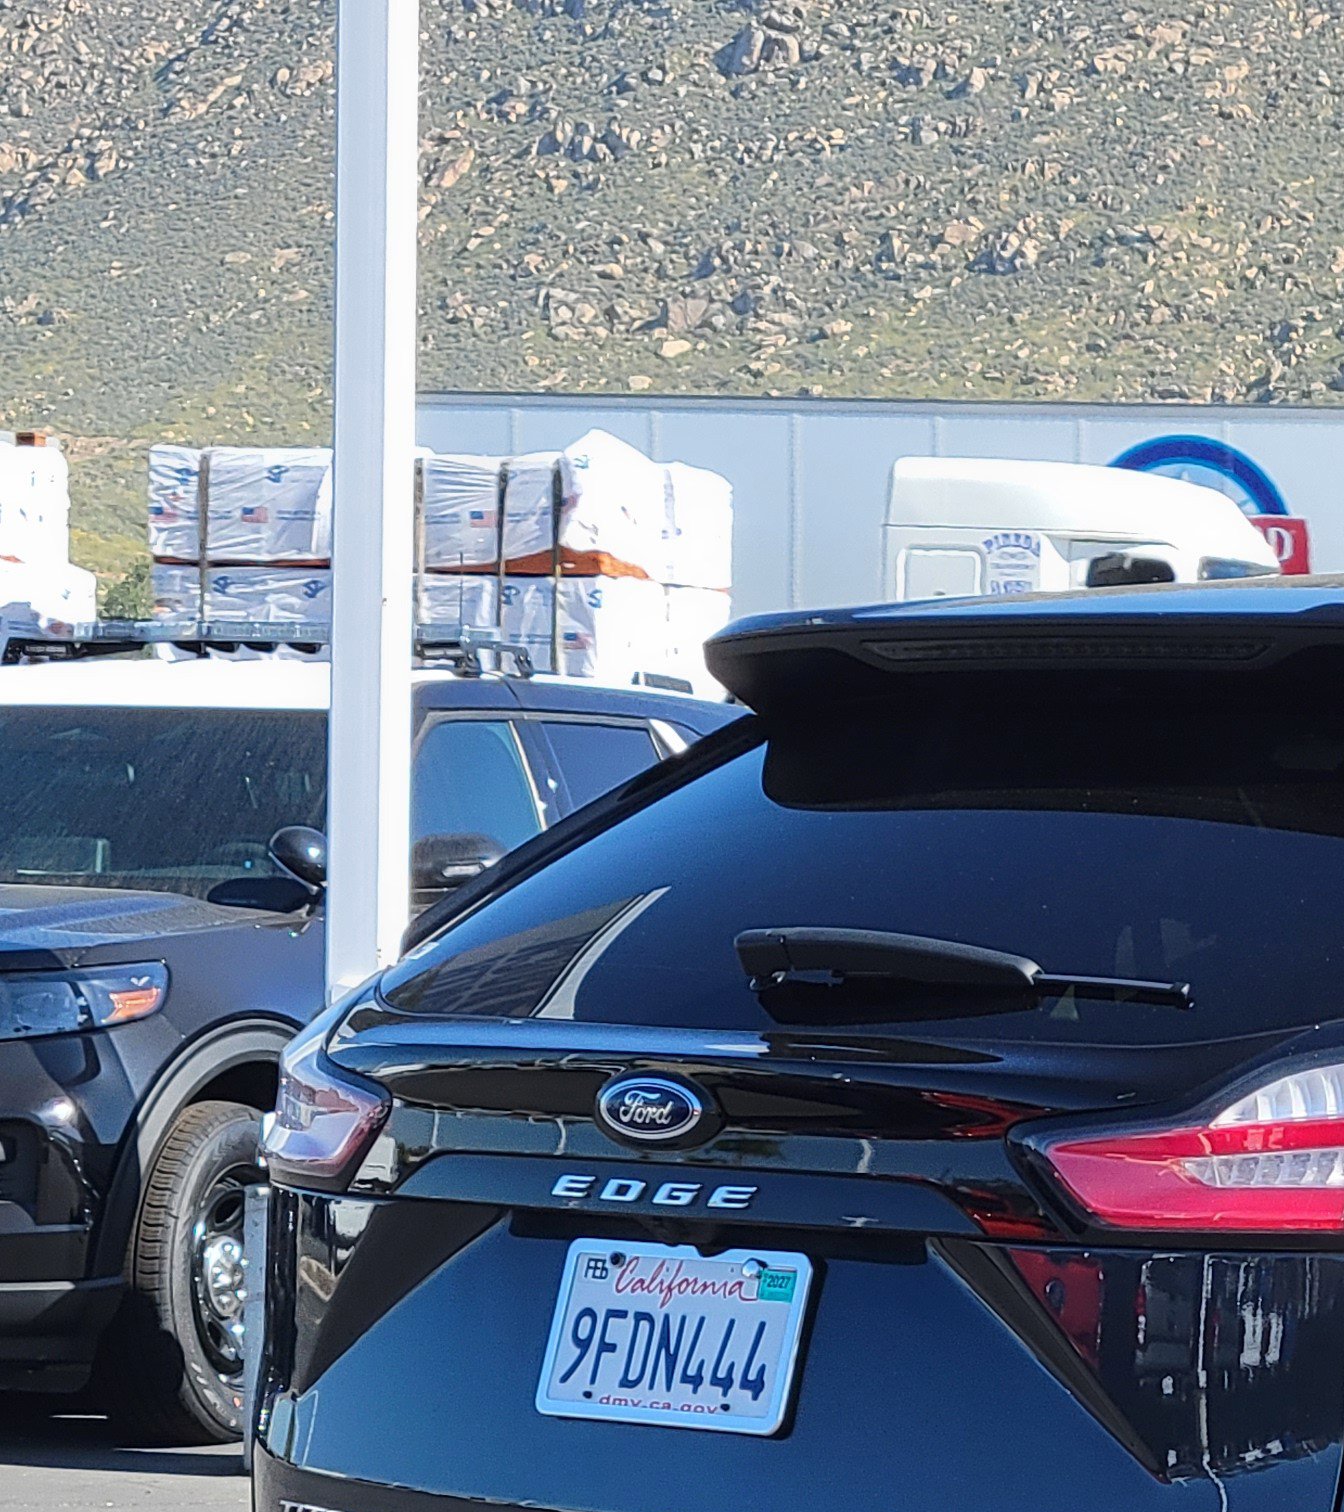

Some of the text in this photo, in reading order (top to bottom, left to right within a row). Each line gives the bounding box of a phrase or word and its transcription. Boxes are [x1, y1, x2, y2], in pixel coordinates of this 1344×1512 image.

[619, 1090, 674, 1125] Ford
[551, 1174, 758, 1209] EDGE
[614, 1255, 758, 1309] California
[766, 1275, 792, 1289] 2027
[558, 1306, 767, 1401] 9FDN444
[599, 1394, 719, 1415] dmv.ca.gov
